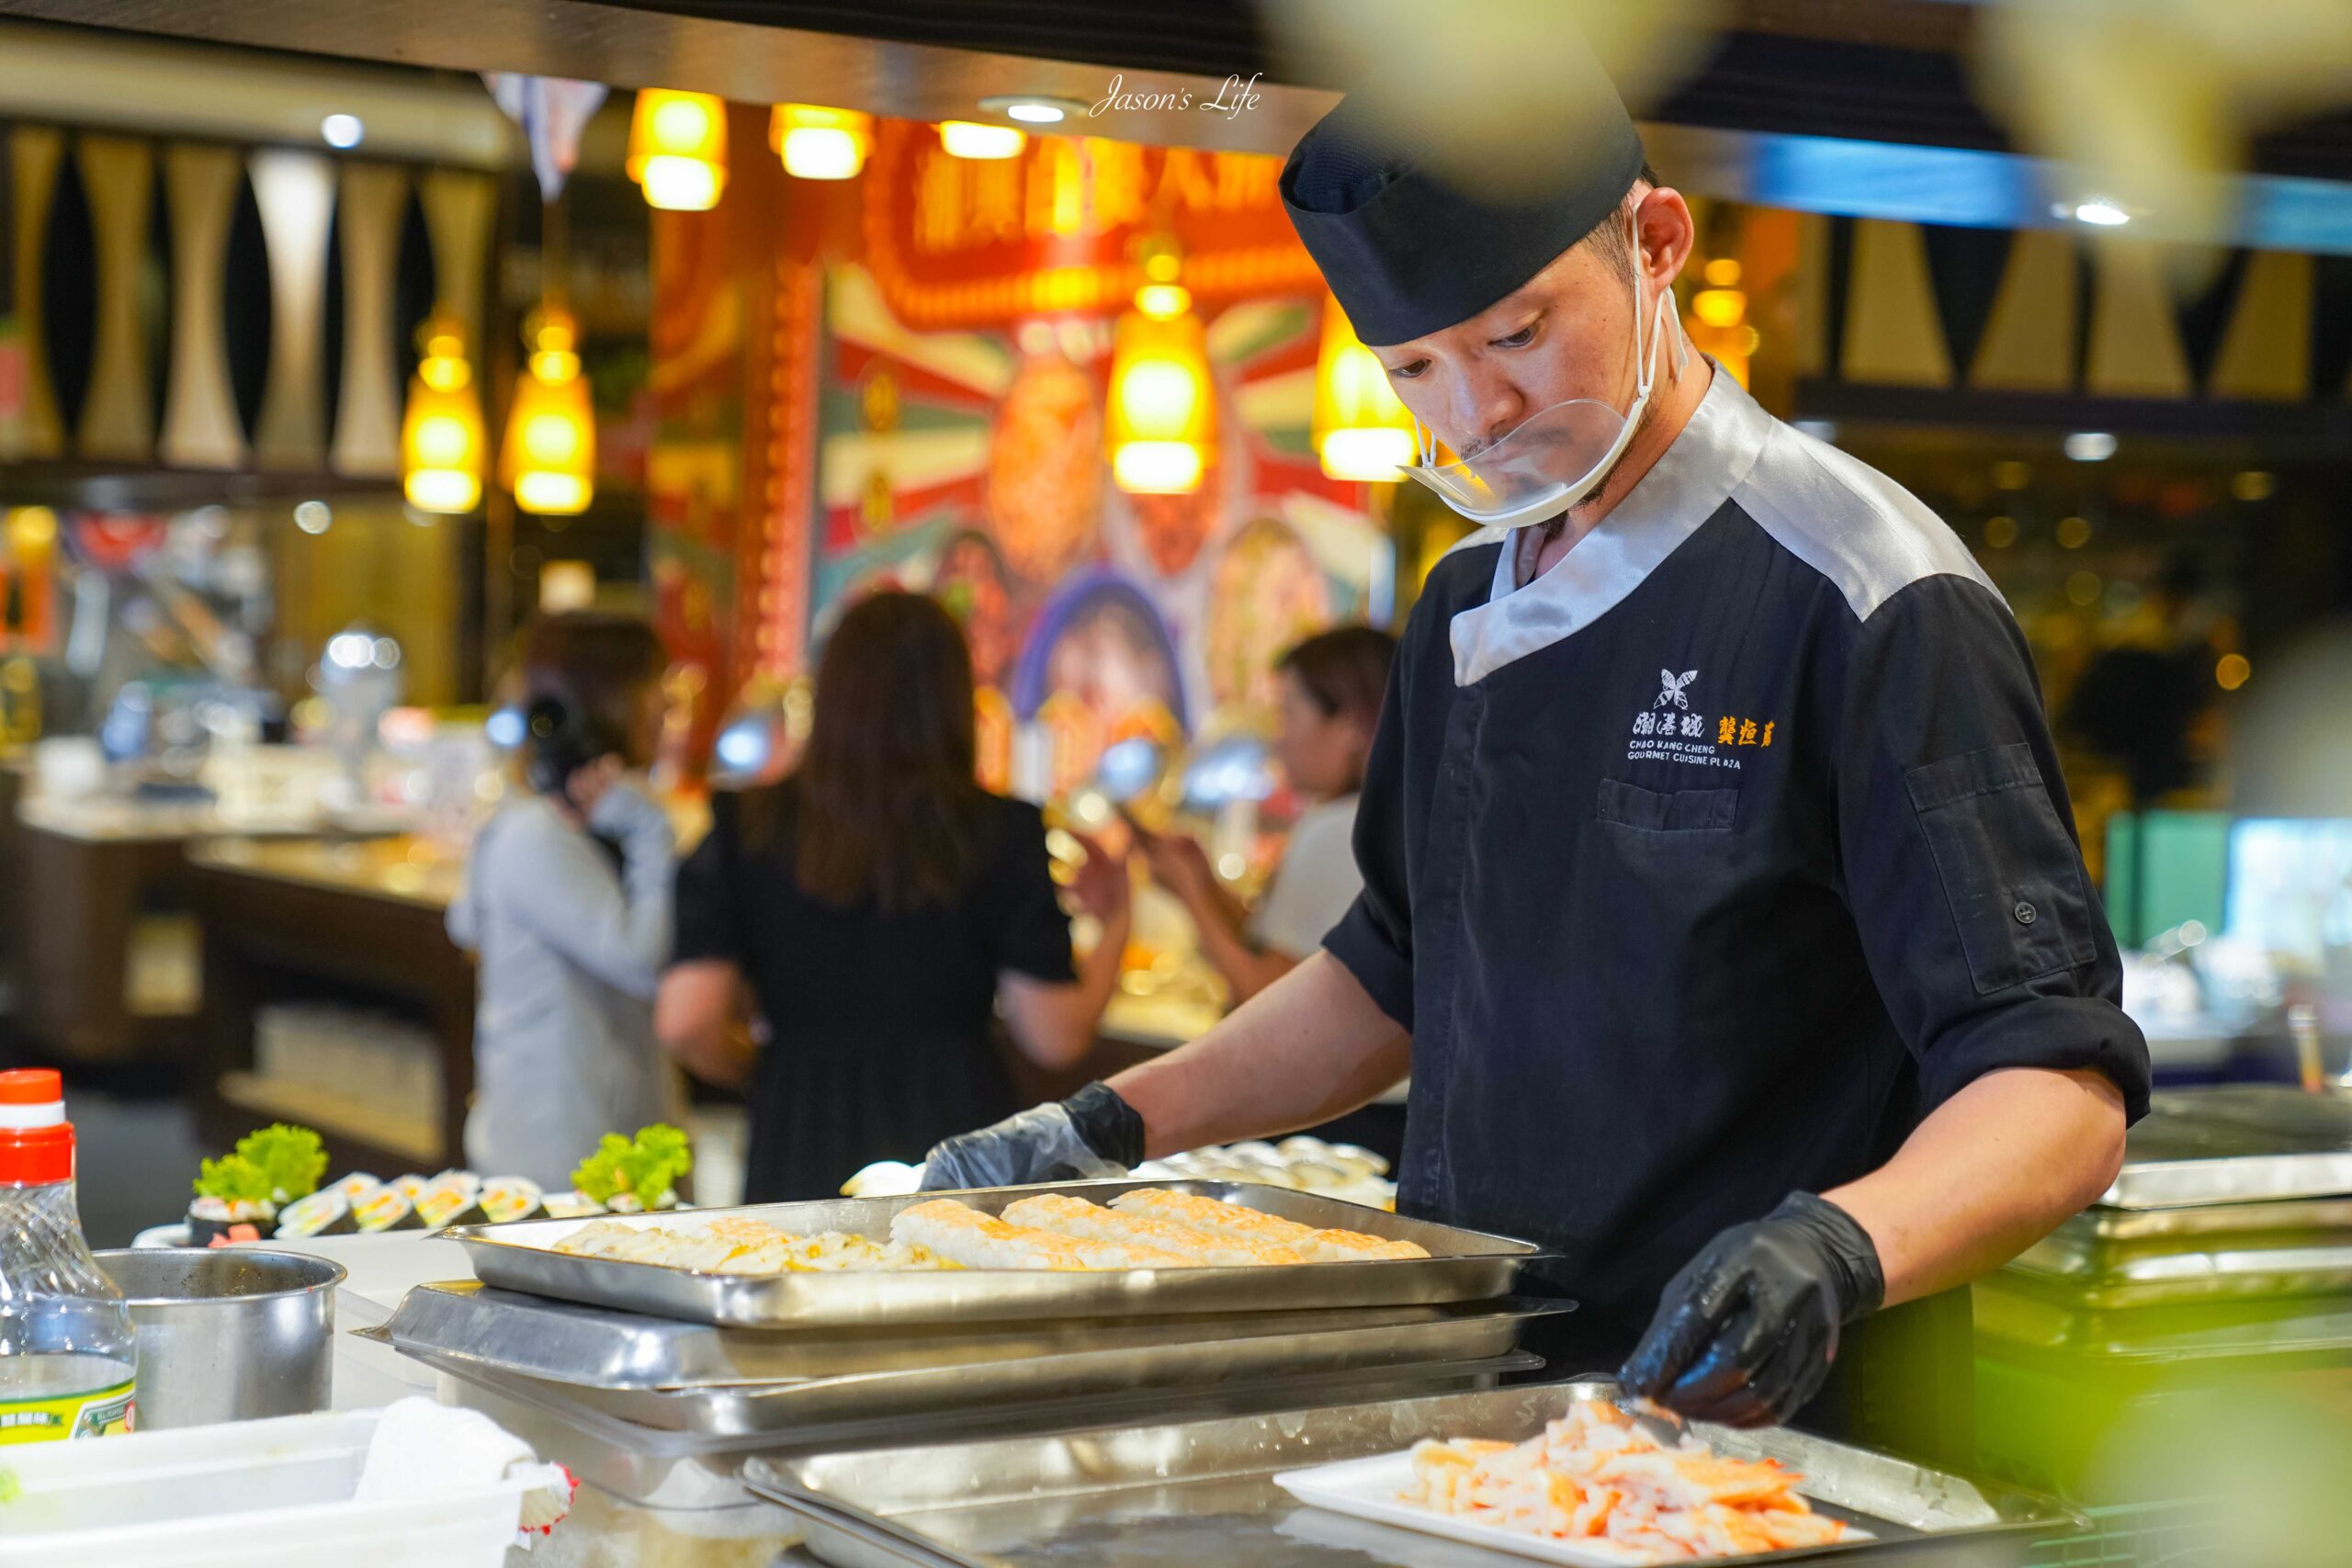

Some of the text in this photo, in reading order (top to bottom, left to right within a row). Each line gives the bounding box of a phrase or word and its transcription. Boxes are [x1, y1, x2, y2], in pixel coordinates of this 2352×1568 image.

[1629, 739, 1716, 756] CHAO KANG CHENG
[1627, 750, 1670, 761] GOURMET
[1672, 753, 1708, 766] CUISINE
